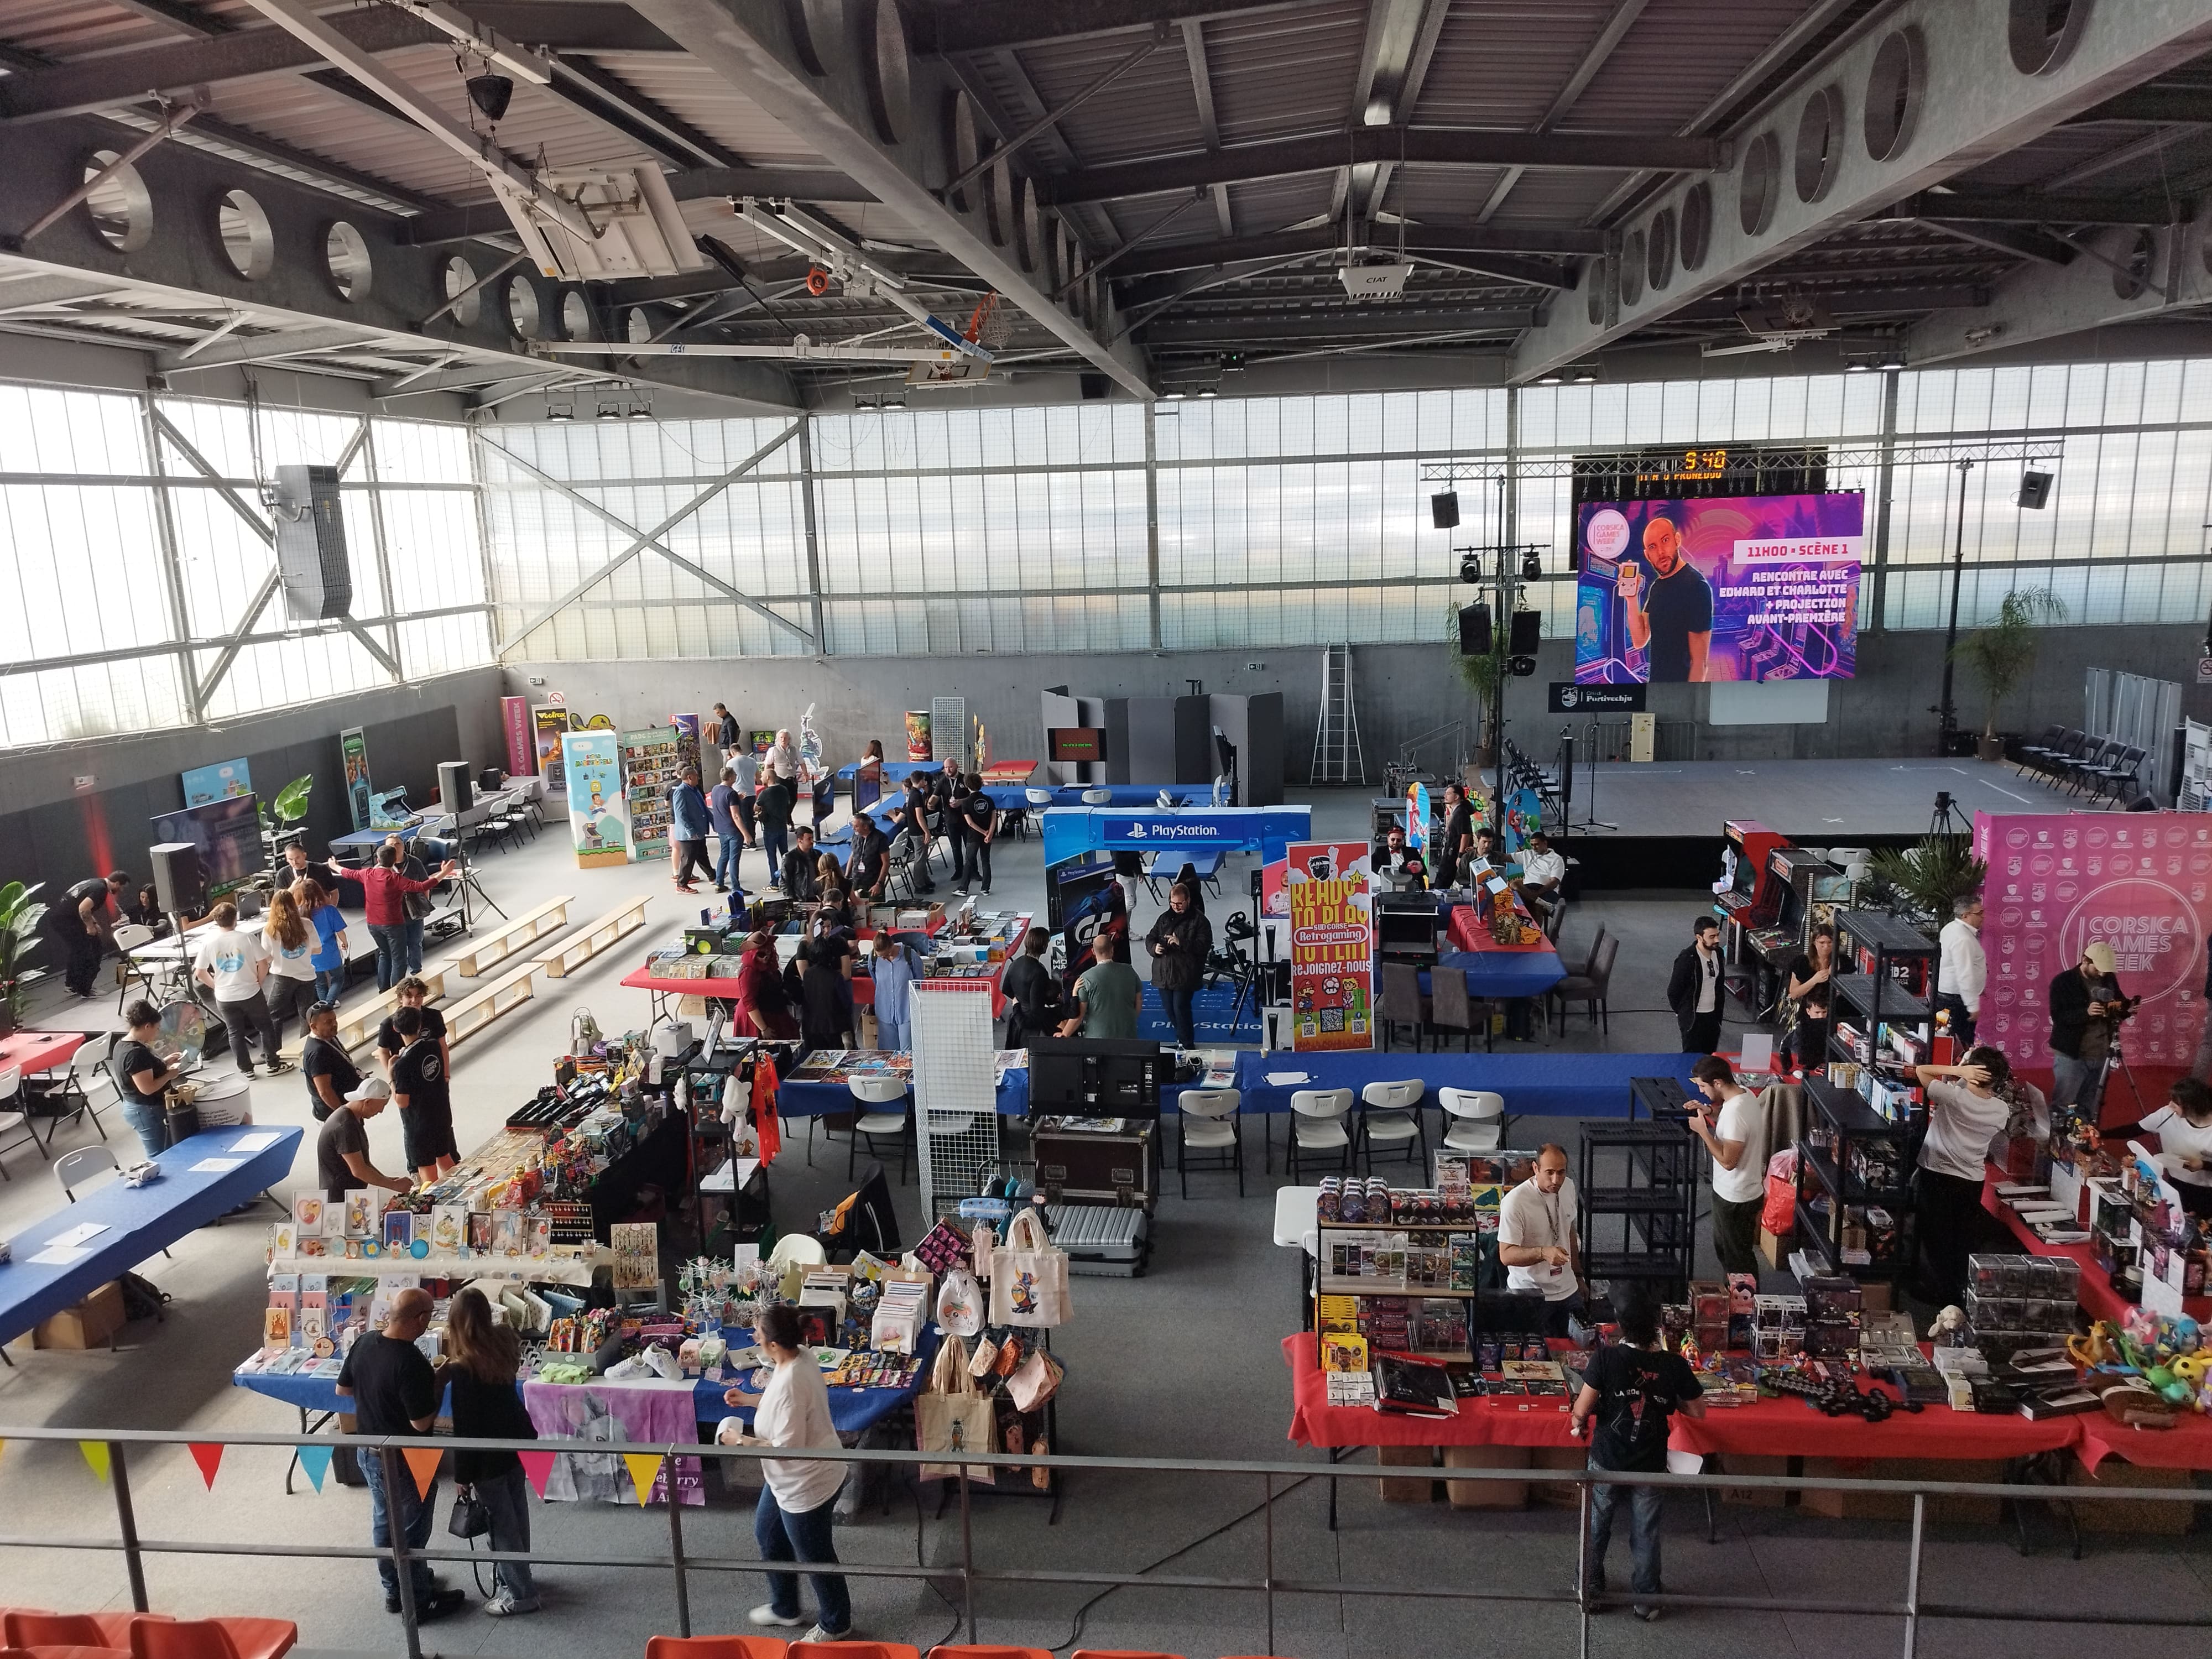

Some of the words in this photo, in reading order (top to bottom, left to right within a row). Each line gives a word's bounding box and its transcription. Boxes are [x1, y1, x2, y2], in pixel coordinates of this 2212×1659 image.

[1747, 545, 1787, 557] 11H00
[1798, 542, 1839, 555] SCÈNE
[1841, 544, 1848, 554] 1
[1752, 570, 1818, 582] RENCONTRE
[1819, 570, 1848, 581] AVEC
[1719, 586, 1765, 597] EDWARD
[1767, 585, 1781, 596] ET
[1782, 584, 1847, 596] CHARLOTTE
[1775, 598, 1846, 610] PROJECTION
[1747, 609, 1845, 625] AVANT-PREMIÈRE
[513, 702, 522, 729] WEEK
[515, 731, 525, 763] GAMES
[1152, 823, 1218, 839] PlayStation
[1291, 878, 1355, 907] READY
[2089, 916, 2189, 934] CORSICA
[1300, 930, 1361, 943] Retrogaming
[2115, 954, 2154, 972] EEK
